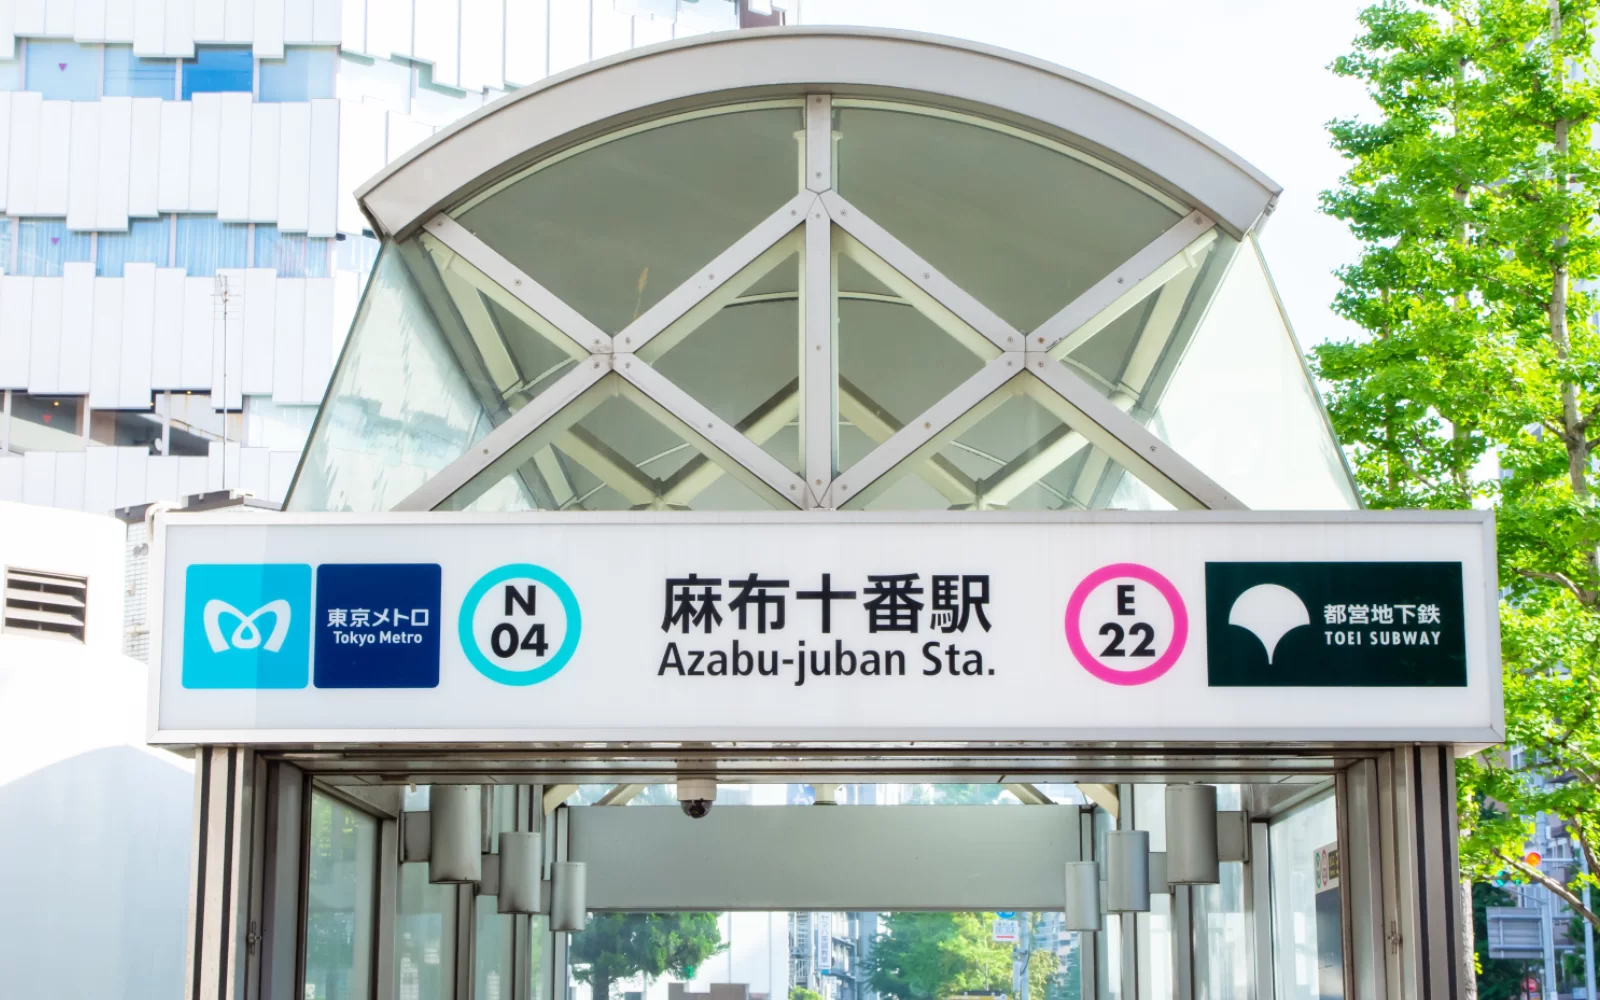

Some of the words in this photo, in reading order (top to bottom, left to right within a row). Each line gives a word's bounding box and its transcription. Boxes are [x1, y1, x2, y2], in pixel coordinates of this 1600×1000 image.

[504, 585, 537, 616] N
[660, 572, 992, 634] 麻布十番駅
[1117, 584, 1136, 616] E
[1323, 603, 1441, 625] 都営地下鉄
[327, 608, 429, 628] 東京メトロ
[333, 631, 376, 647] Tokyo
[379, 631, 423, 645] Metro
[490, 622, 549, 659] 04
[1098, 622, 1156, 657] 22
[1325, 631, 1362, 646] TOEI
[1370, 631, 1441, 646] SUBWAY
[657, 639, 906, 687] Azabu-juban
[922, 641, 996, 676] Sta.
